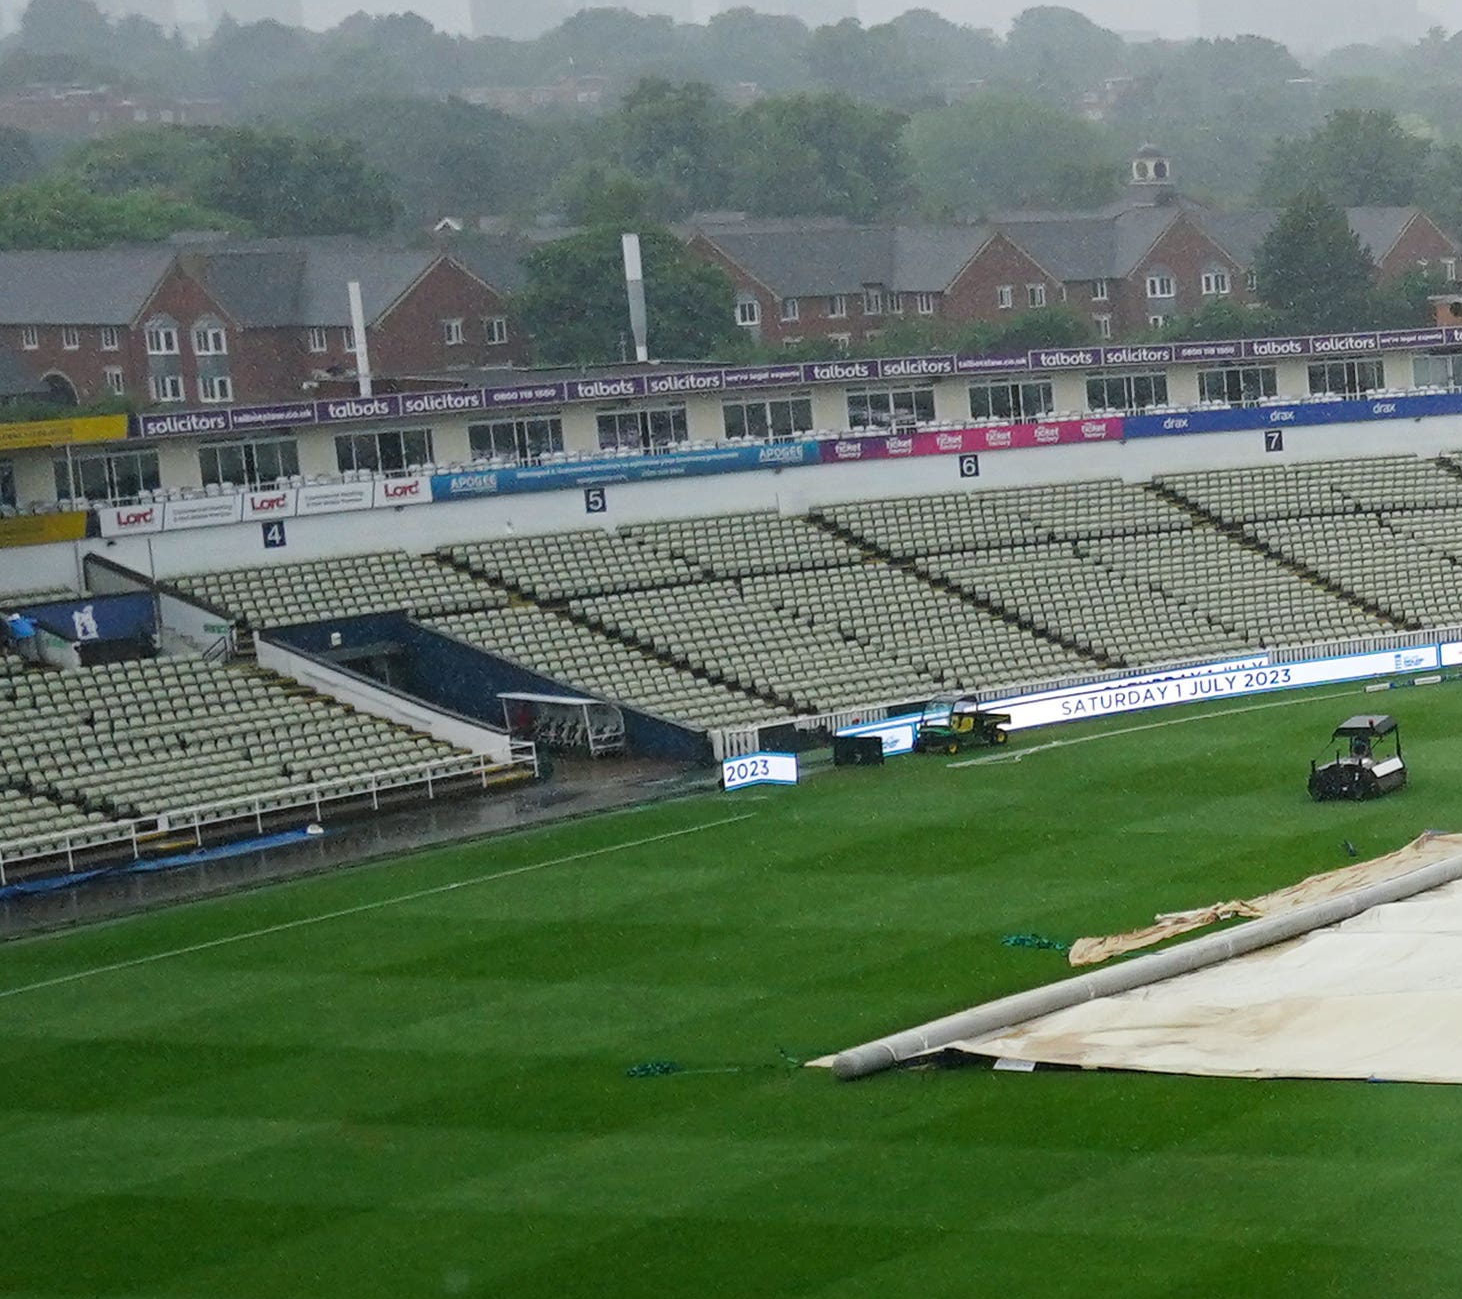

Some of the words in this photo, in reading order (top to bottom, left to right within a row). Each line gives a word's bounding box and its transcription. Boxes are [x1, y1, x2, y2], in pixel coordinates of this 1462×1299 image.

[1041, 350, 1092, 367] talbots
[1106, 347, 1169, 364] solicitors
[813, 363, 869, 380] talbots
[884, 356, 952, 375] solicitors
[577, 380, 634, 398] talbots
[651, 373, 720, 393] solicitors
[328, 398, 389, 418] talbots
[1270, 410, 1295, 423] drax
[1373, 402, 1396, 415] drax
[147, 410, 226, 435] solicitors
[1164, 416, 1189, 429] drax
[1267, 432, 1280, 450] 7
[963, 456, 976, 476] 6
[588, 491, 603, 511] 5
[267, 525, 281, 544] 4
[1061, 685, 1168, 716] SATURDAY
[1189, 676, 1236, 697] JULY
[1244, 669, 1291, 688] 2023
[726, 759, 770, 782] 2023
